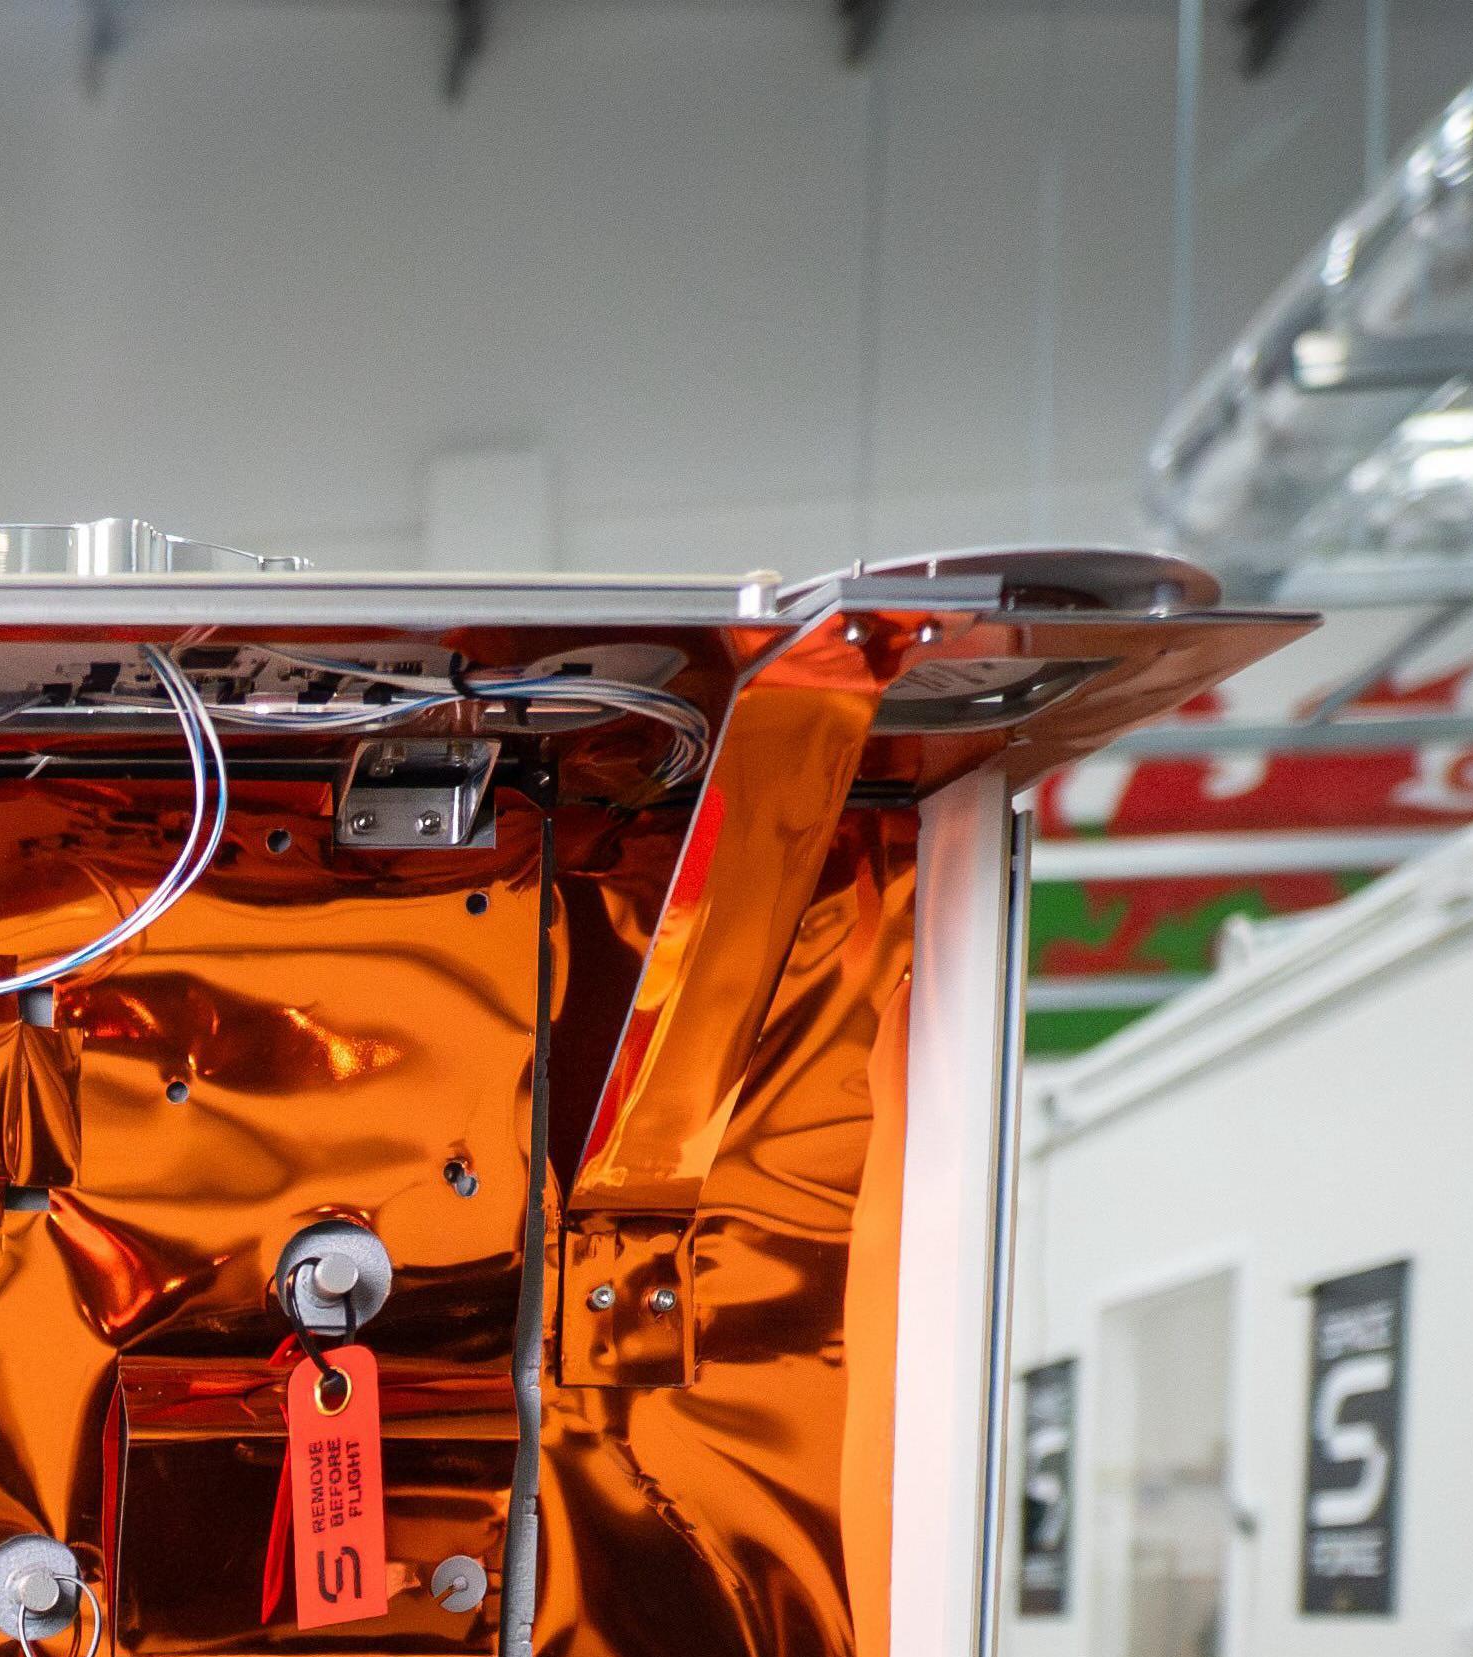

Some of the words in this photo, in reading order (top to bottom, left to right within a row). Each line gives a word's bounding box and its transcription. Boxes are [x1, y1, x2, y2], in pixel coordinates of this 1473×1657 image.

[326, 1437, 344, 1529] BEFORE
[346, 1440, 363, 1518] FLIGHT
[1310, 1354, 1390, 1526] S
[309, 1440, 326, 1534] REMOVE
